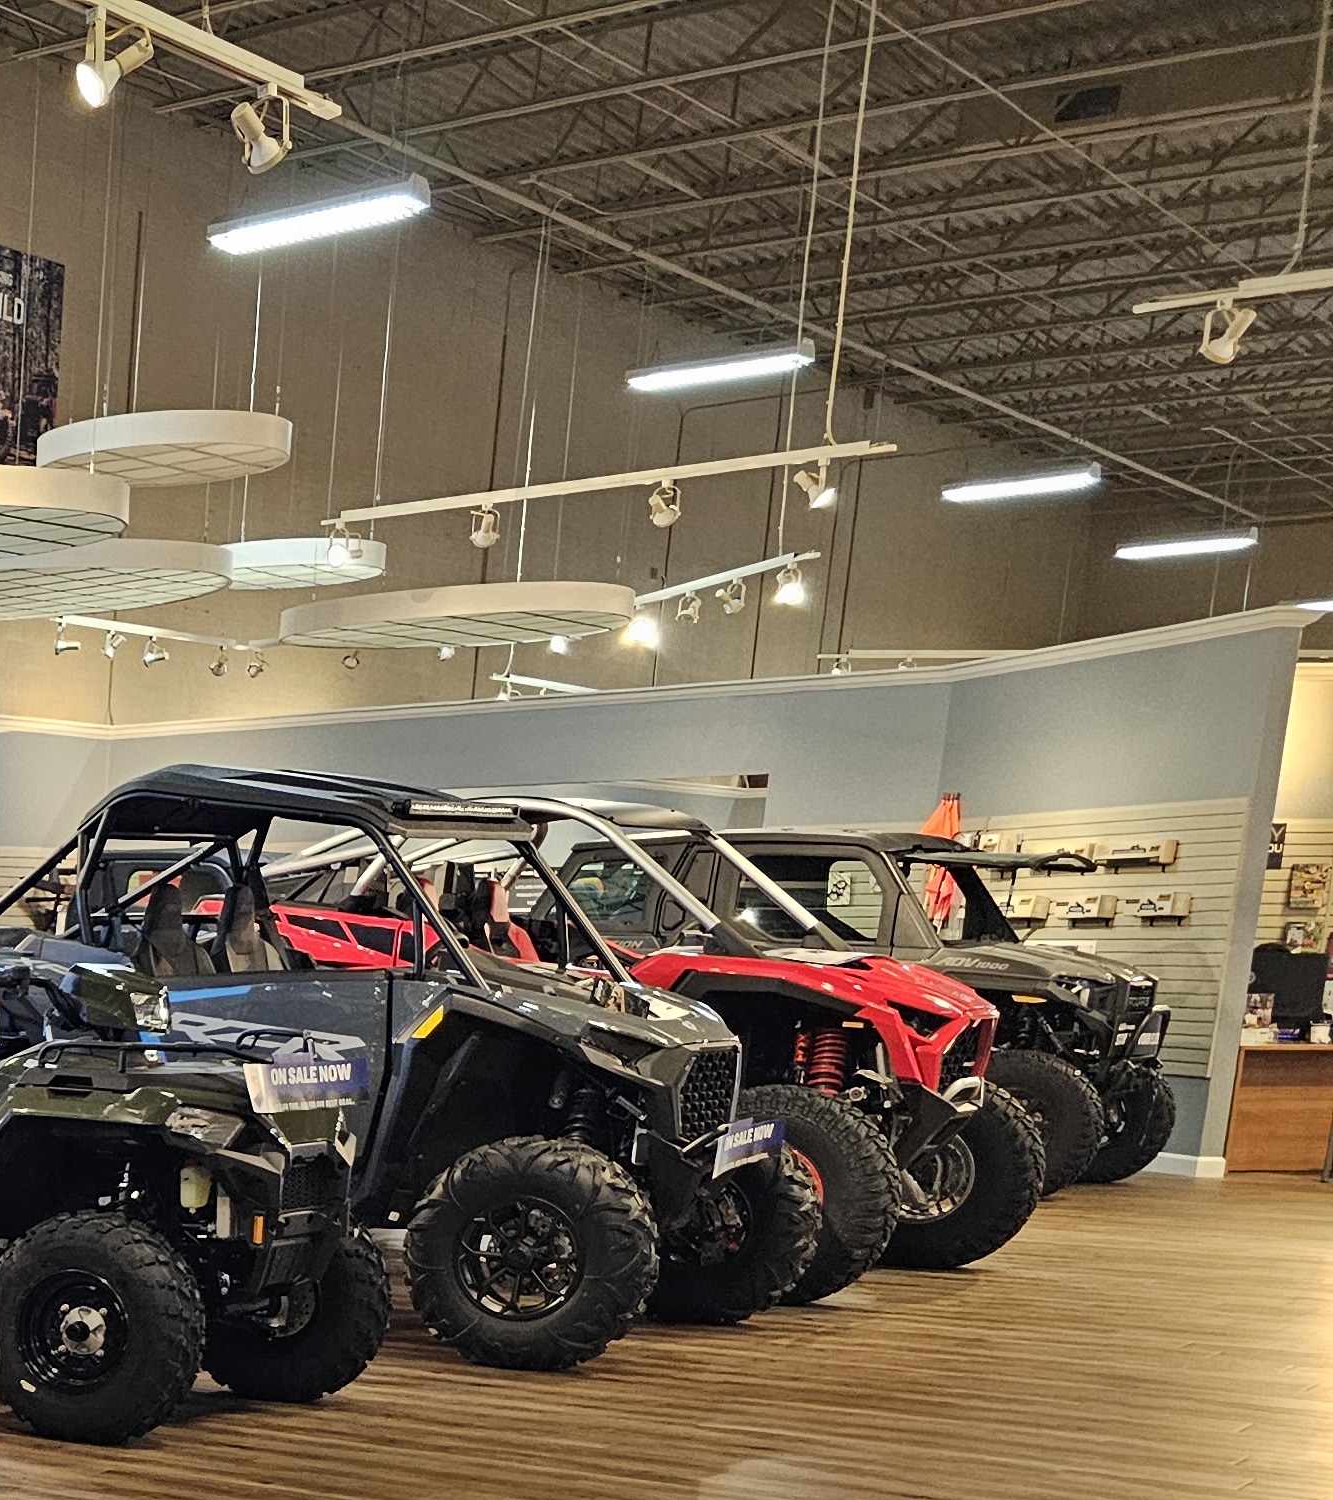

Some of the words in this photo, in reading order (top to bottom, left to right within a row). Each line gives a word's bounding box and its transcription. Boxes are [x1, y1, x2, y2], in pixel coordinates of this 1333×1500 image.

[270, 1066, 288, 1086] ON
[288, 1064, 318, 1085] SALE
[319, 1062, 352, 1083] NOW
[733, 1127, 754, 1149] SALE
[754, 1122, 775, 1142] NOW
